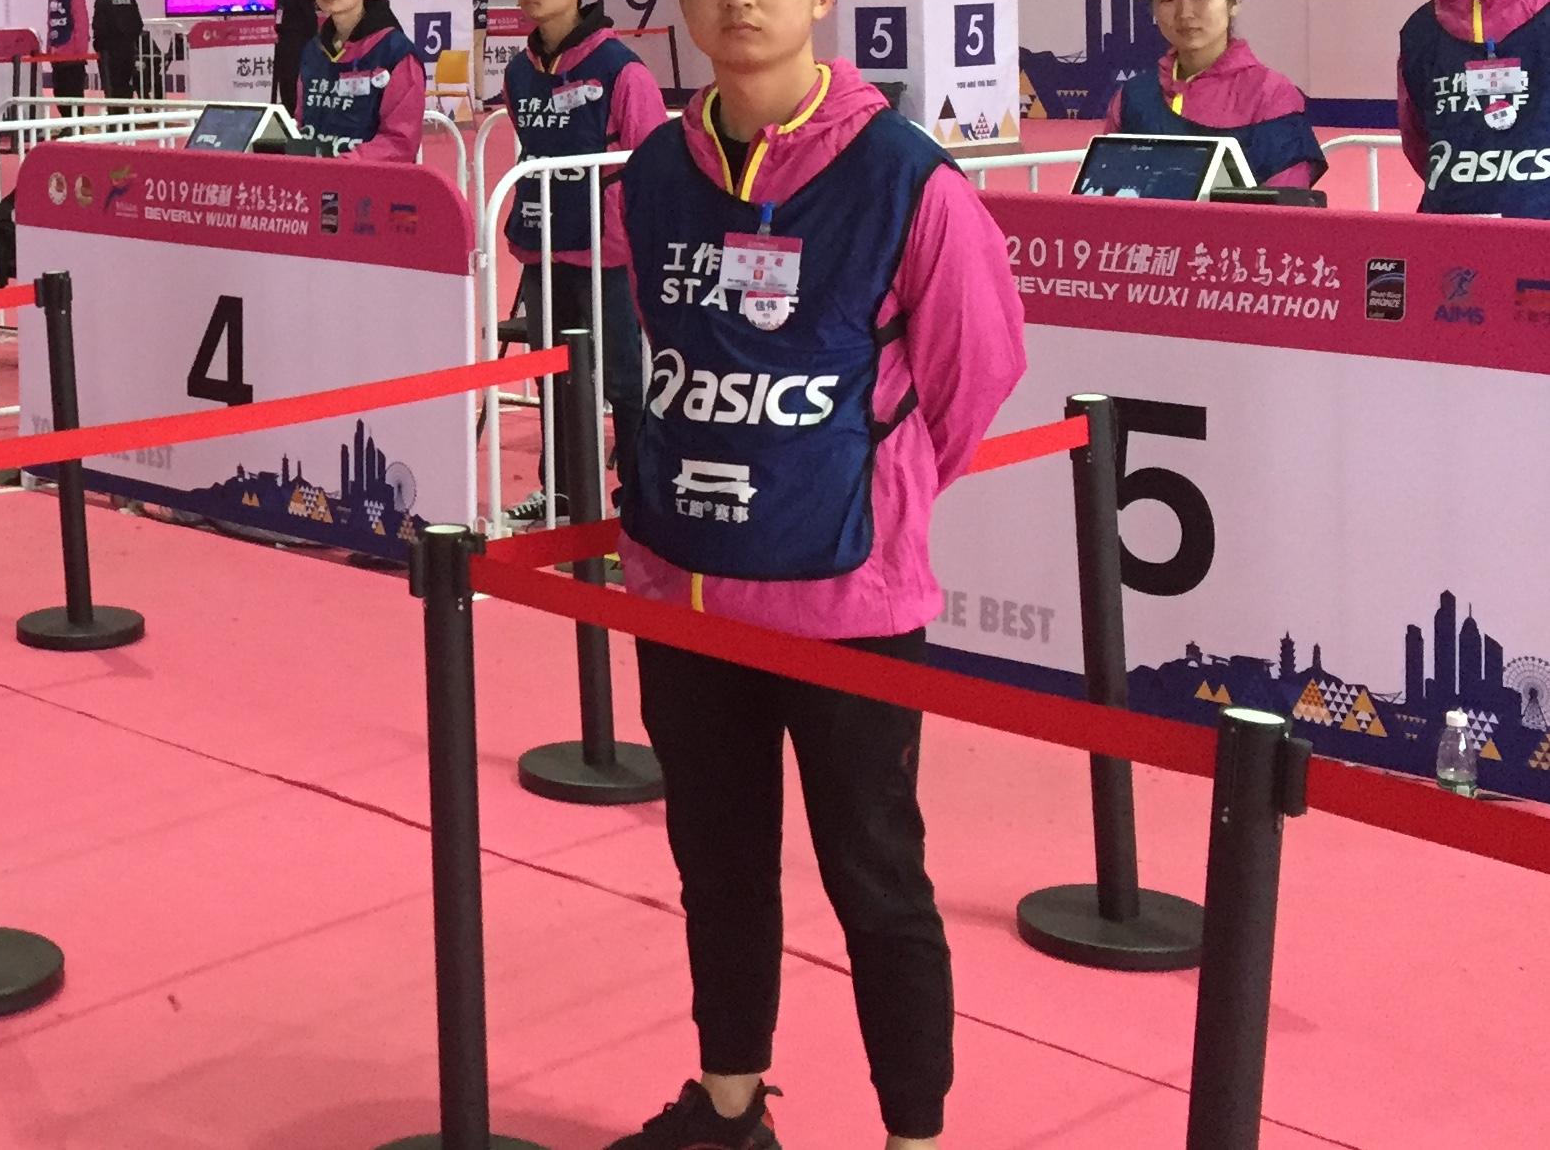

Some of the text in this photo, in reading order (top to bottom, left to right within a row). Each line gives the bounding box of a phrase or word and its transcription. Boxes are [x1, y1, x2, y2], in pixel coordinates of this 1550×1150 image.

[423, 20, 442, 56] 5
[868, 16, 893, 60] 5
[964, 14, 984, 56] 5
[306, 95, 354, 111] STAFF
[517, 114, 571, 129] STAFF
[145, 178, 189, 203] 2019
[144, 206, 202, 224] BEVERLY
[206, 211, 237, 229] WUXI
[240, 216, 309, 236] MARATHON
[1008, 235, 1092, 271] 2019
[1127, 282, 1189, 308] WUXI
[1196, 289, 1341, 321] MARATHON
[187, 294, 254, 406] 4
[684, 373, 840, 426] asics
[1112, 396, 1216, 597] 5
[979, 595, 1055, 644] BEST
